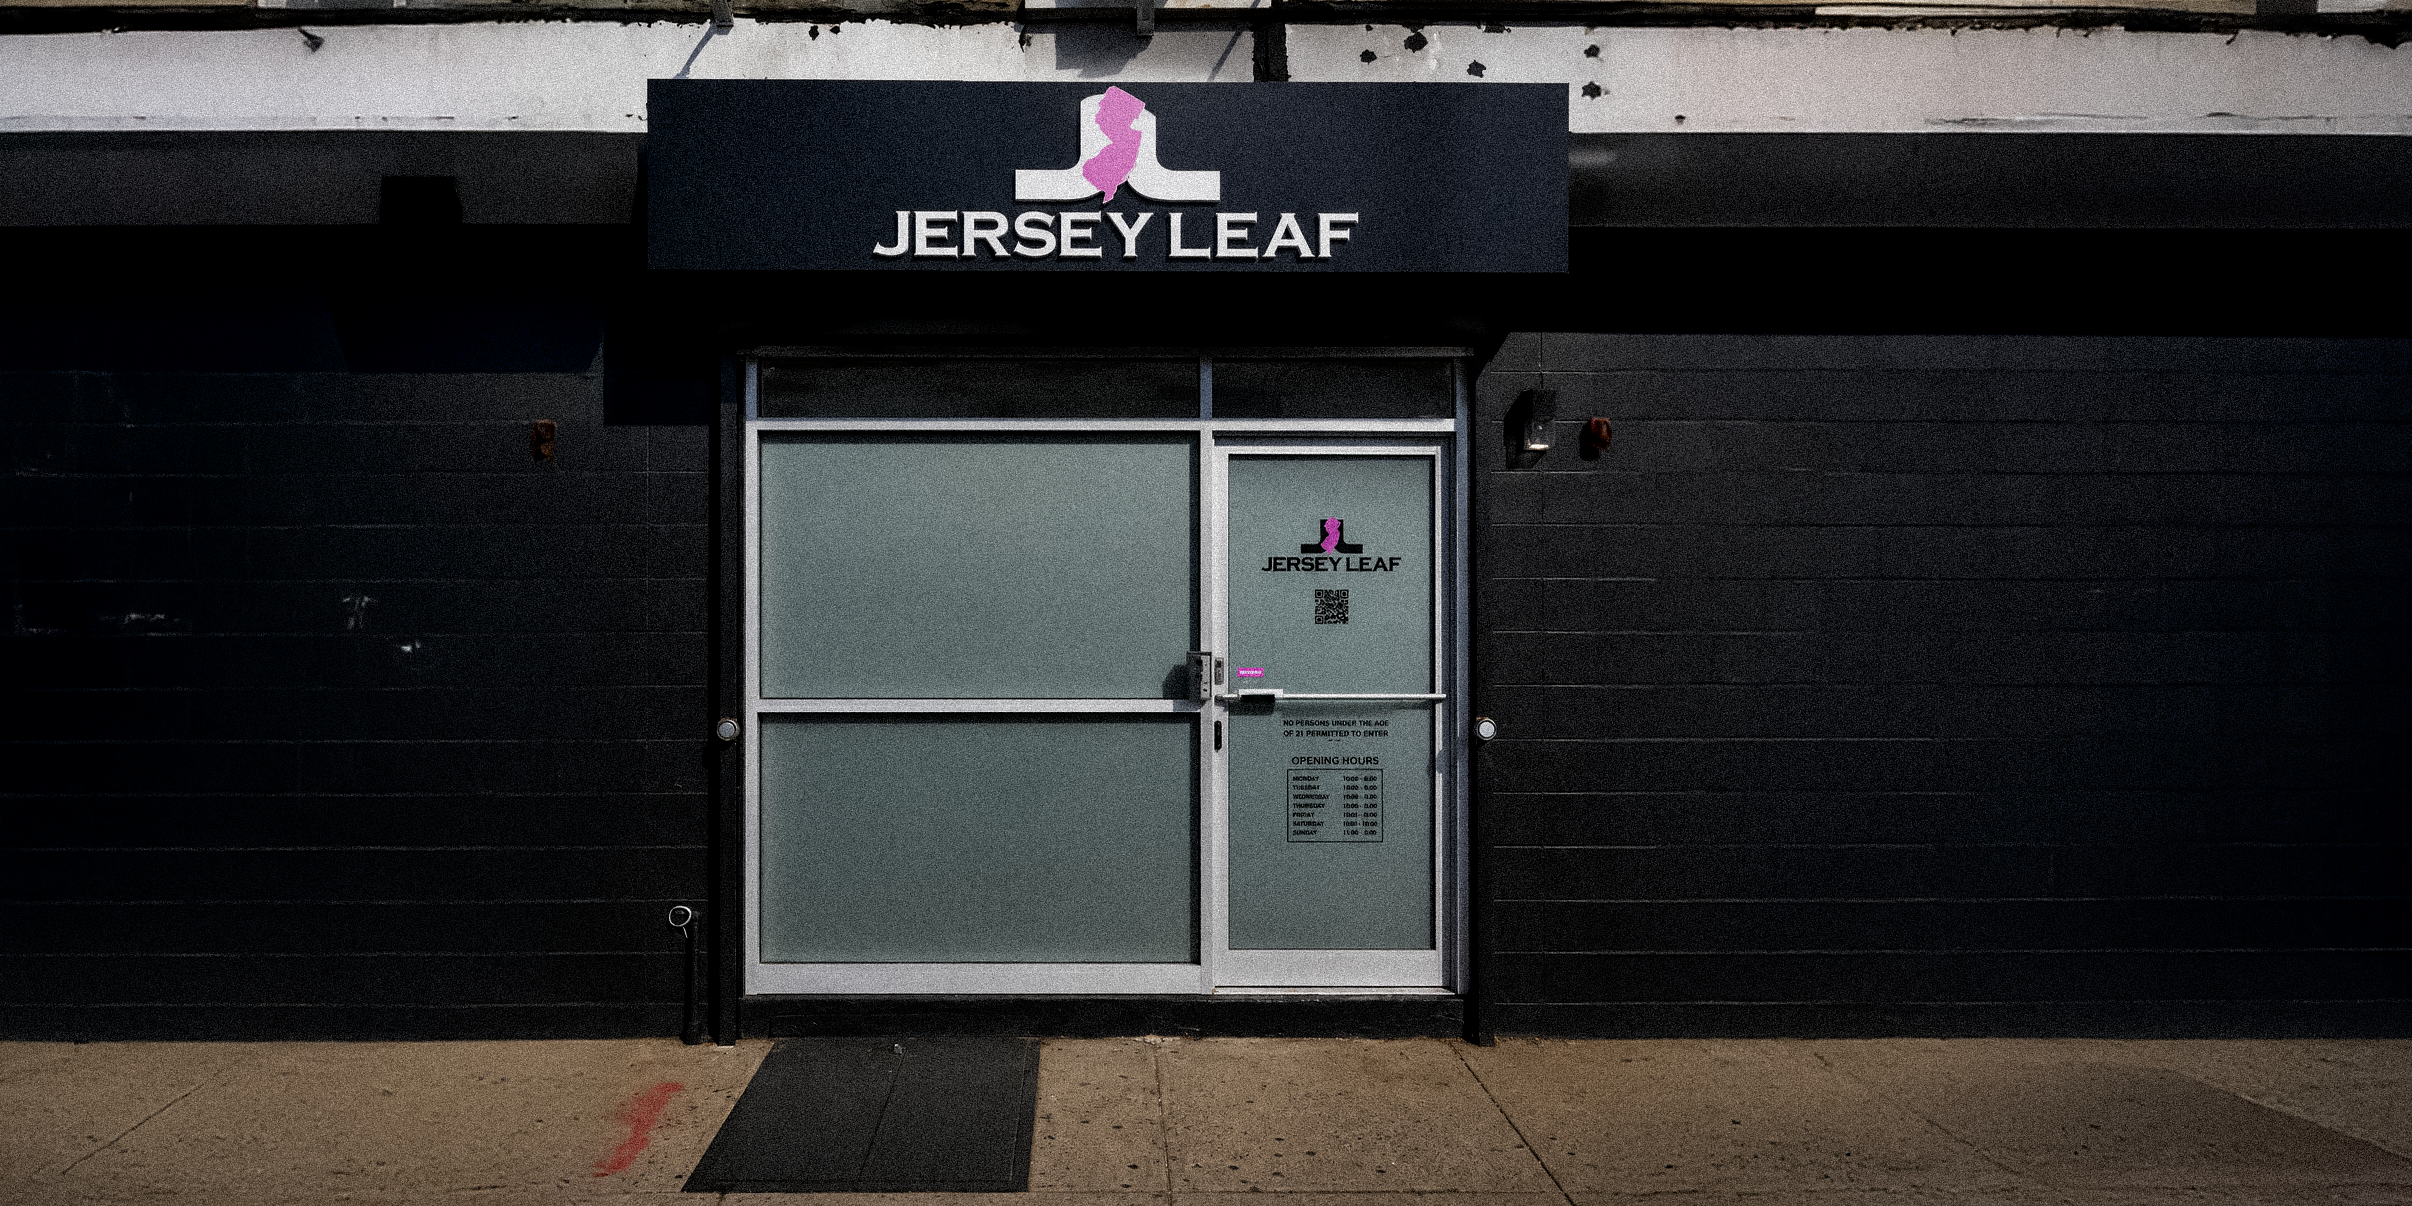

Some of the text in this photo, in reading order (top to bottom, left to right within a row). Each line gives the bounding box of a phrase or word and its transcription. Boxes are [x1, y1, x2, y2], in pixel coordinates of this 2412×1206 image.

[872, 209, 1360, 259] JERSEY LEAF
[1261, 556, 1402, 572] JERSEY LEAF
[1283, 719, 1294, 727] NO
[1296, 719, 1330, 727] PERSONS
[1332, 719, 1357, 727] UNDER
[1359, 719, 1372, 727] THE
[1291, 756, 1379, 766] OPENING HOURS
